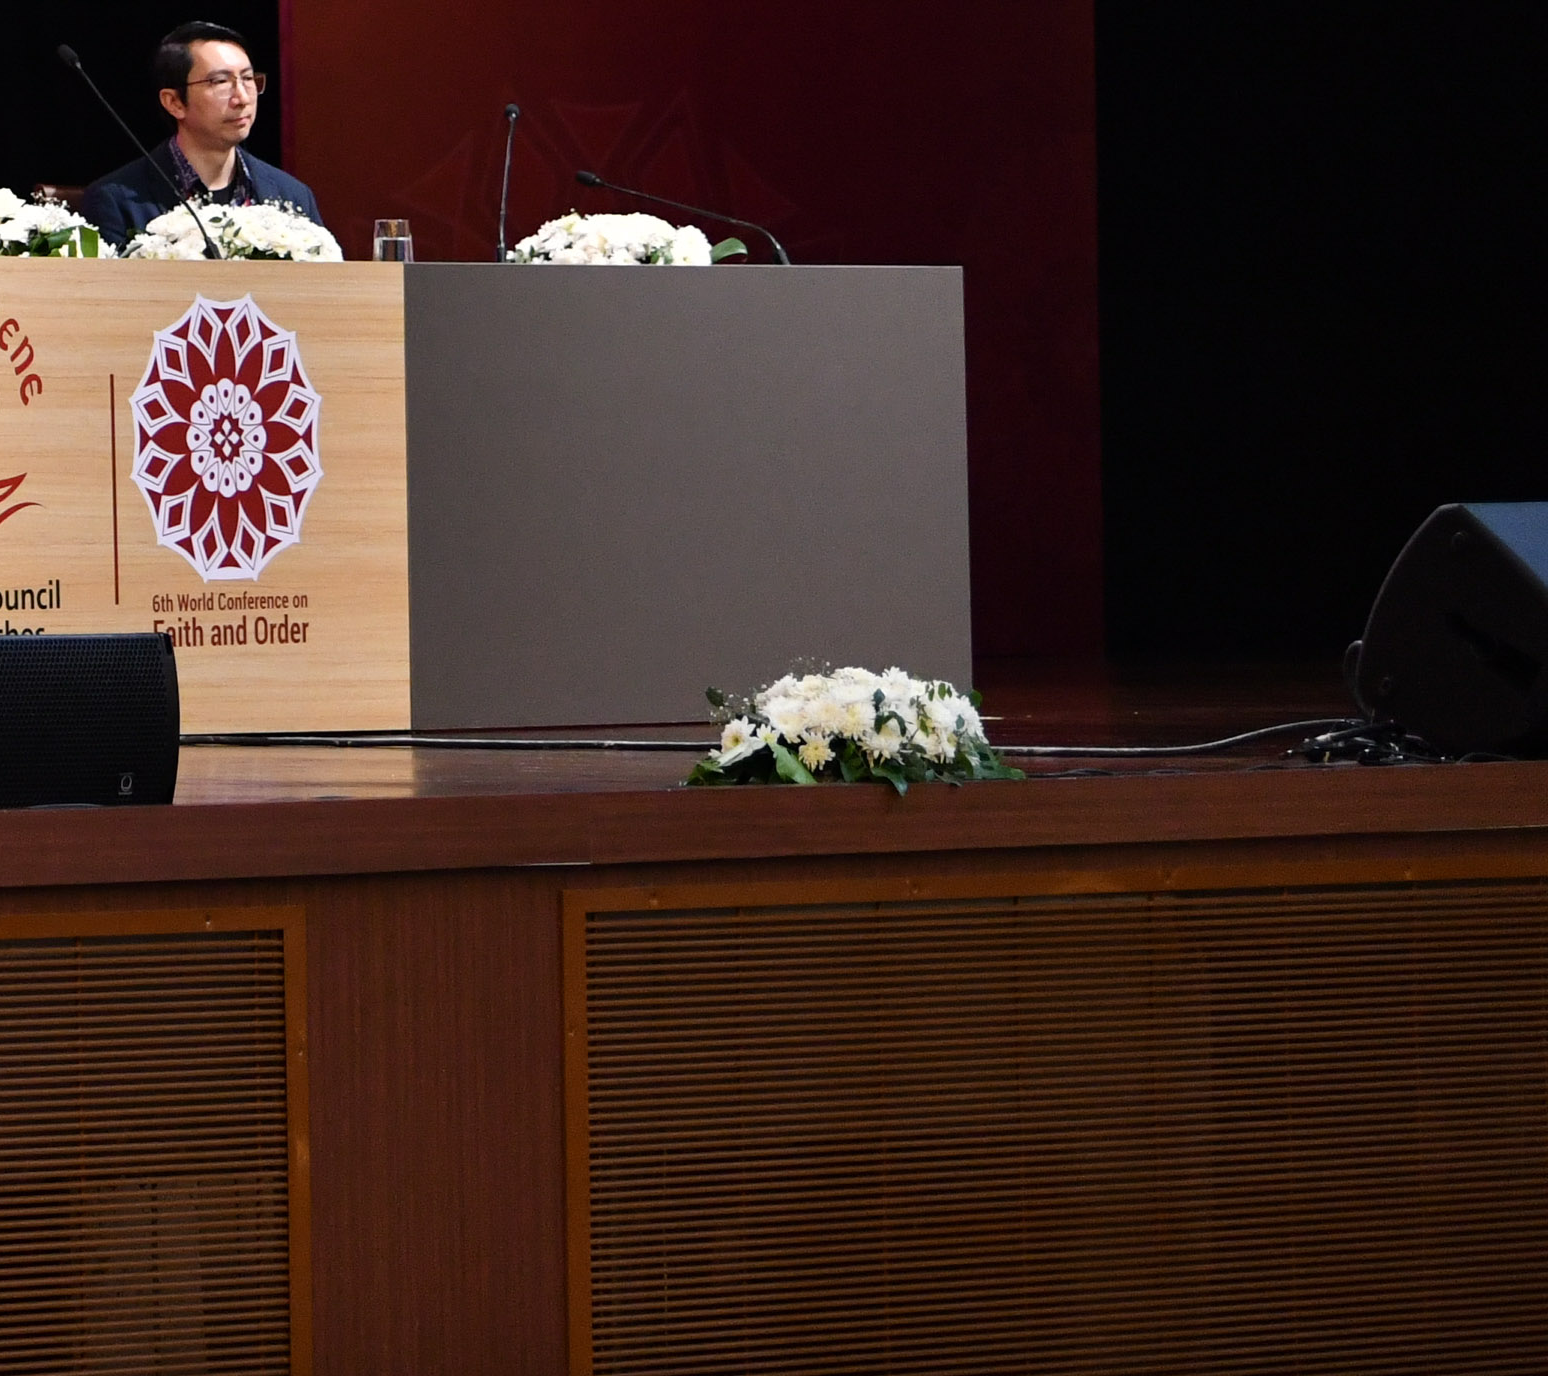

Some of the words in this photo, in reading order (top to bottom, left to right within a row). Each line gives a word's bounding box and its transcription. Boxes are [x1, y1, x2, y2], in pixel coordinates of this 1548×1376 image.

[152, 593, 174, 612] 6th
[177, 592, 214, 611] World
[218, 591, 289, 610] Conference
[292, 594, 308, 608] on
[211, 615, 247, 646] and
[254, 614, 309, 645] Order
